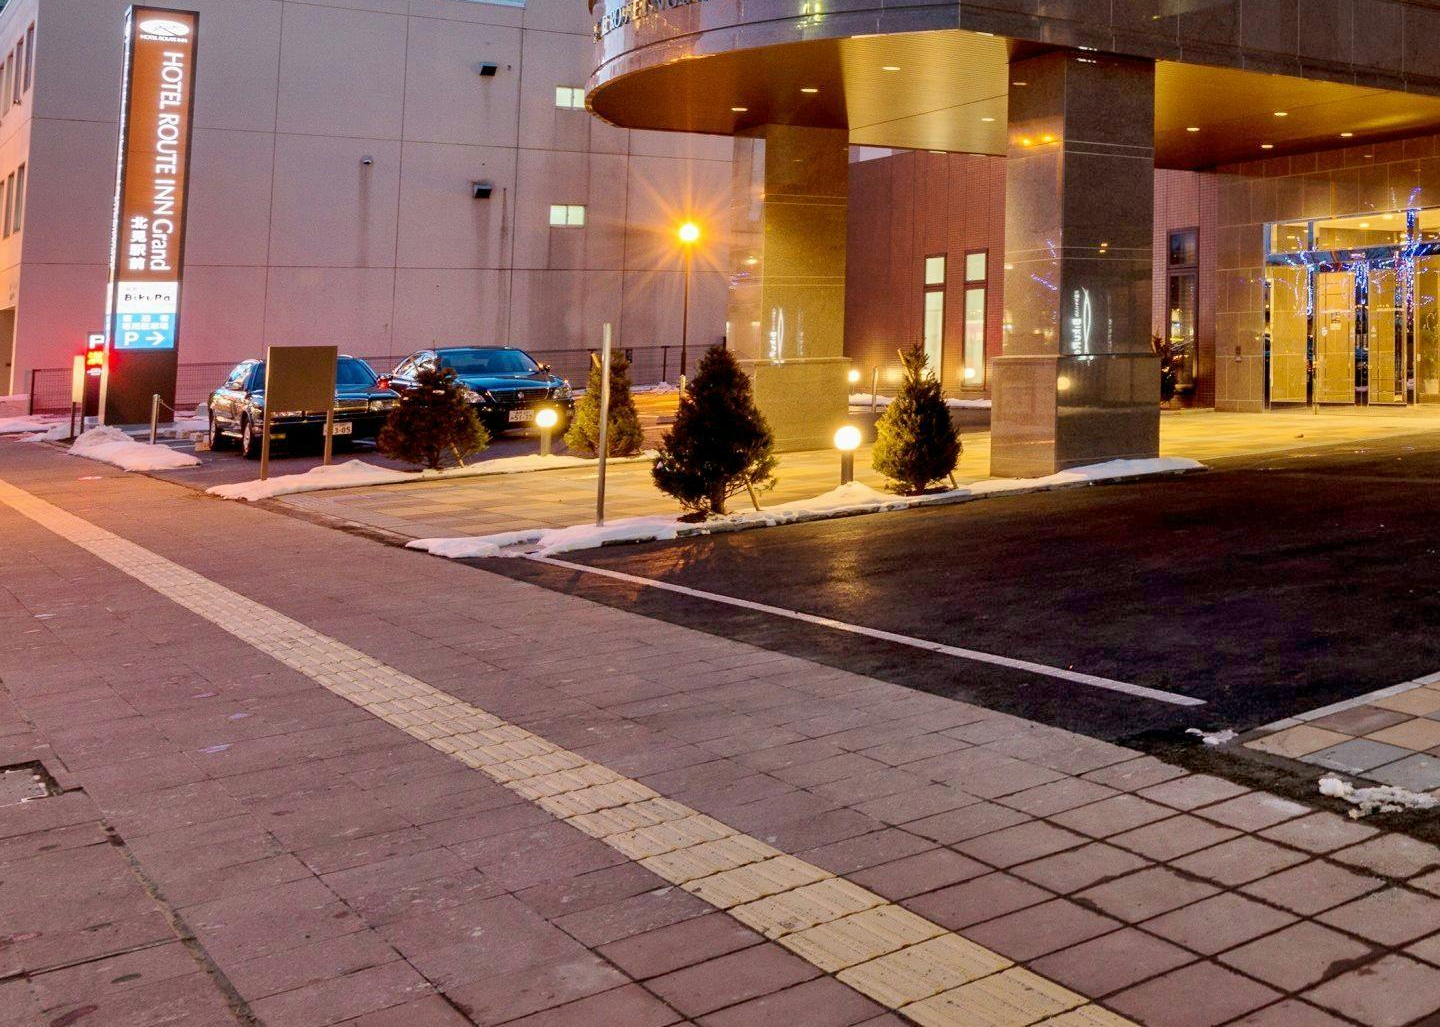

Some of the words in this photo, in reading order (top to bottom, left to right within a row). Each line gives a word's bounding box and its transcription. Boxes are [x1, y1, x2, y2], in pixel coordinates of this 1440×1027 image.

[160, 51, 184, 109] HOTEL
[155, 113, 180, 174] ROUTE
[153, 179, 176, 215] INN
[150, 218, 173, 271] Grand
[89, 334, 105, 349] P
[124, 331, 139, 346] P
